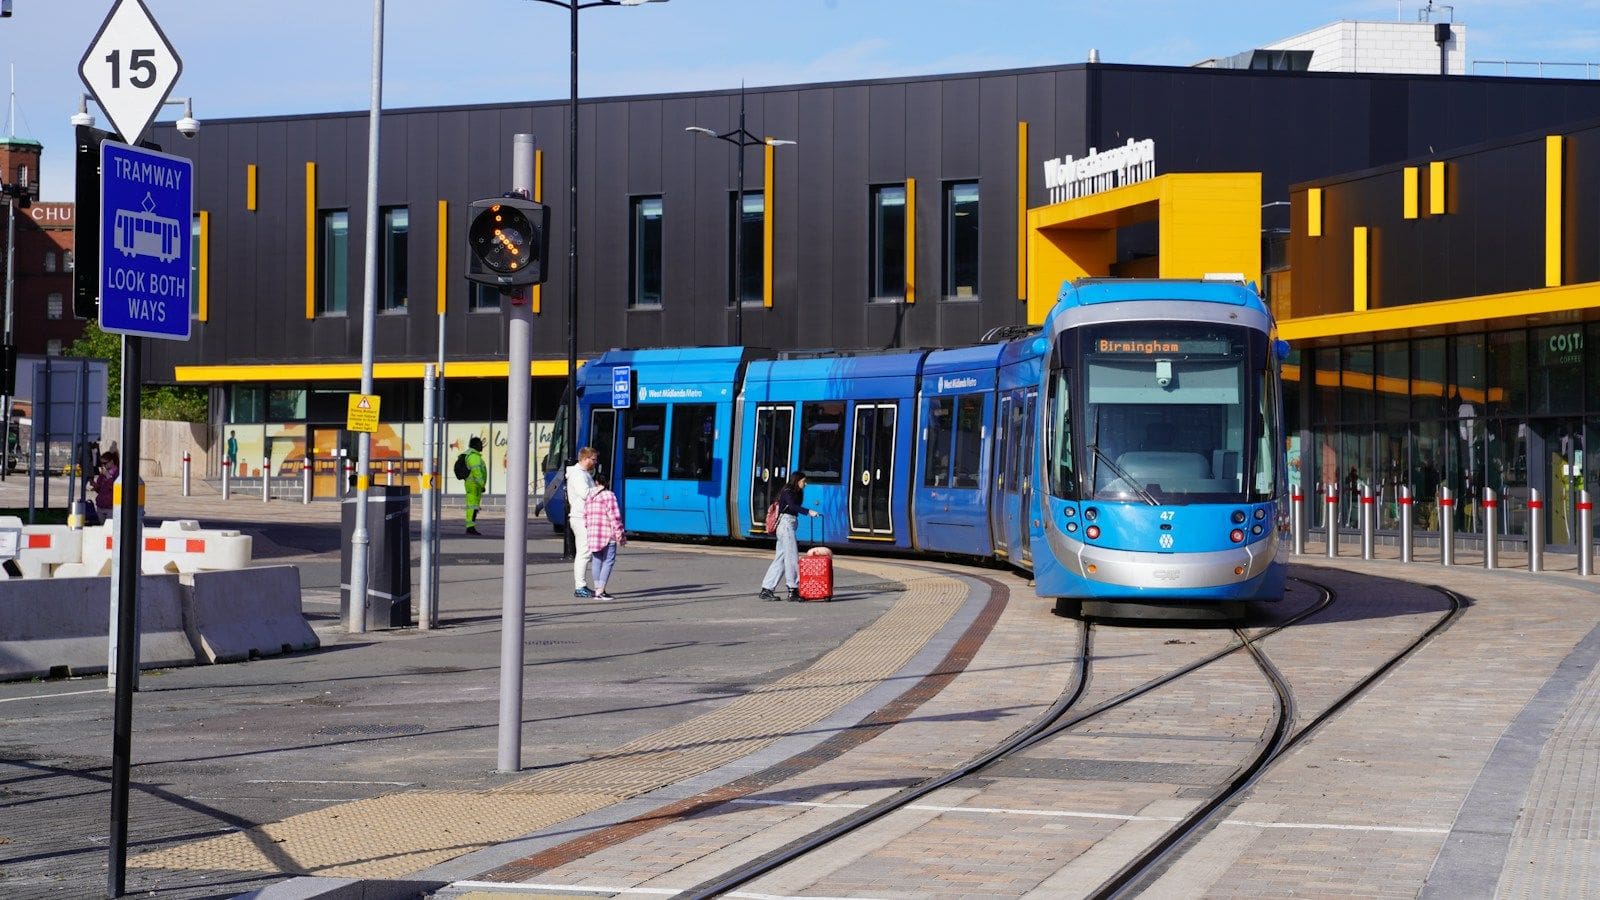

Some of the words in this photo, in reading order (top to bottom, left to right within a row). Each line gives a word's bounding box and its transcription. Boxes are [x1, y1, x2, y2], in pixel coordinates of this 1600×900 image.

[106, 49, 157, 89] 15
[114, 156, 182, 190] TRAMWAY
[108, 267, 146, 293] LOOK
[150, 273, 185, 298] BOTH
[128, 297, 166, 322] WAYS
[1100, 340, 1179, 353] Birmingham
[1160, 511, 1175, 520] 47
